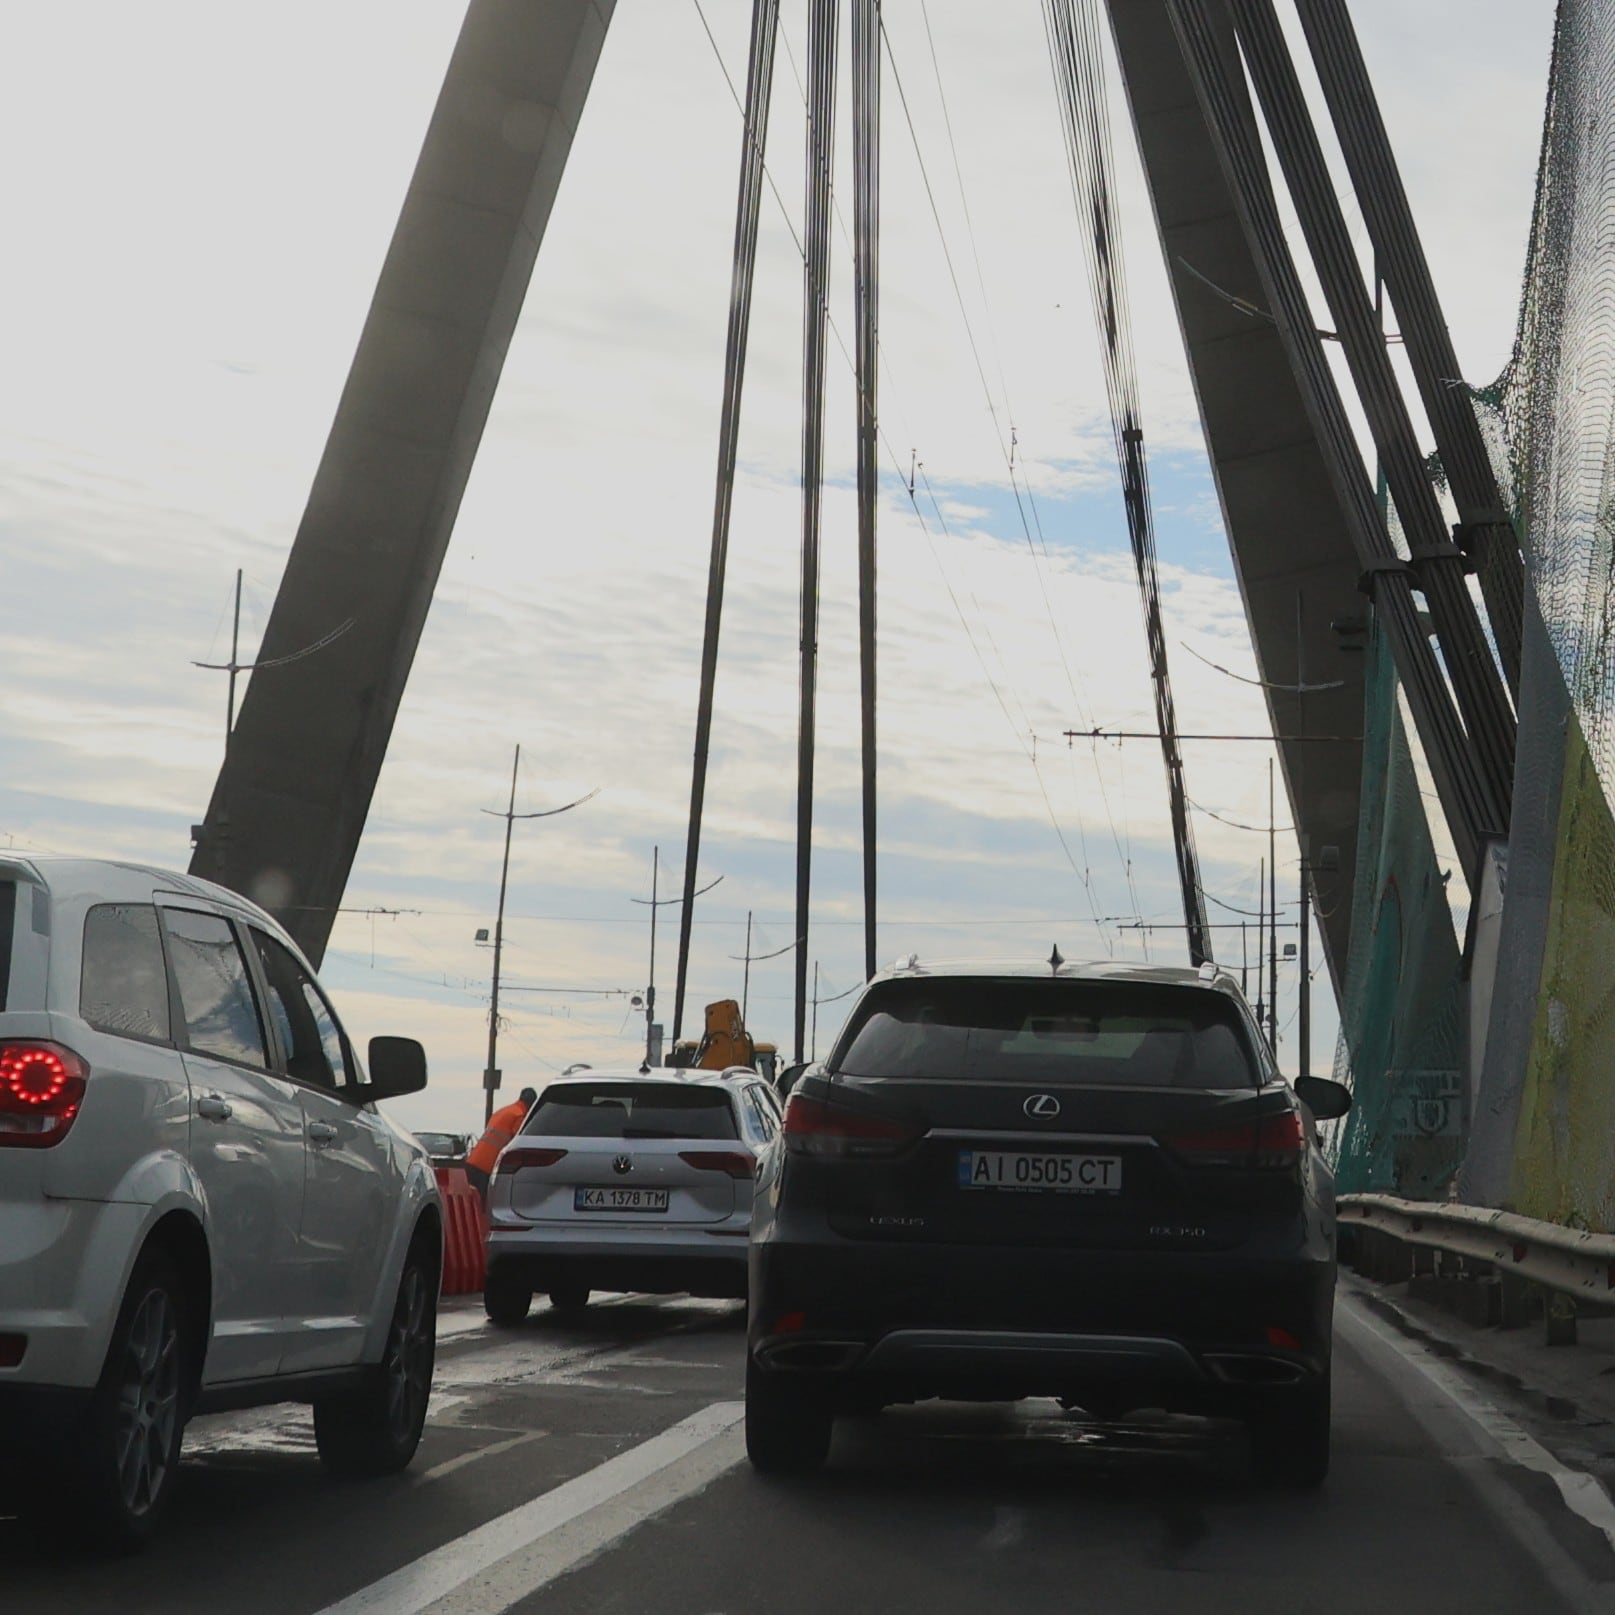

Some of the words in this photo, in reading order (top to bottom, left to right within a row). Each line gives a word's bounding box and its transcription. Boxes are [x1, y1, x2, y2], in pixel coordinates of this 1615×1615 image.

[974, 1155, 1004, 1182] AI
[1015, 1156, 1073, 1183] 0505
[1078, 1158, 1116, 1185] CT
[585, 1190, 605, 1205] KA
[609, 1190, 641, 1206] 1378
[644, 1190, 666, 1207] TM
